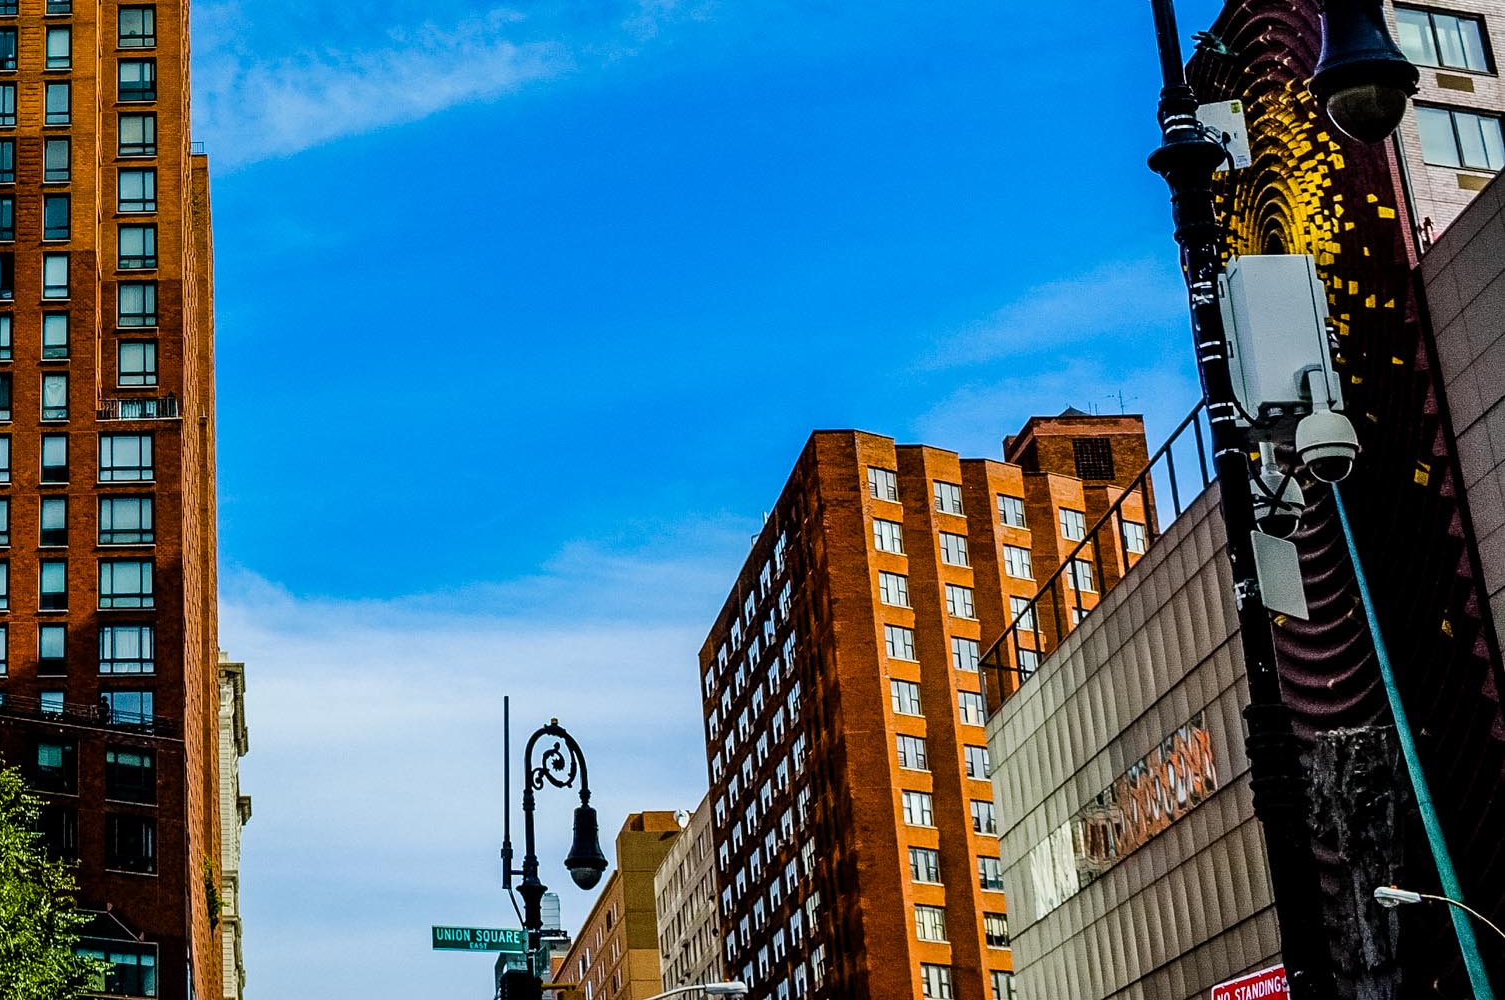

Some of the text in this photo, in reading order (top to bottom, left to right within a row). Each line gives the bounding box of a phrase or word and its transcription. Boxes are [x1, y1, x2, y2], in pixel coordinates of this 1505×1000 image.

[436, 928, 520, 943] UNION SQUARE
[1235, 976, 1280, 1000] STANDING
